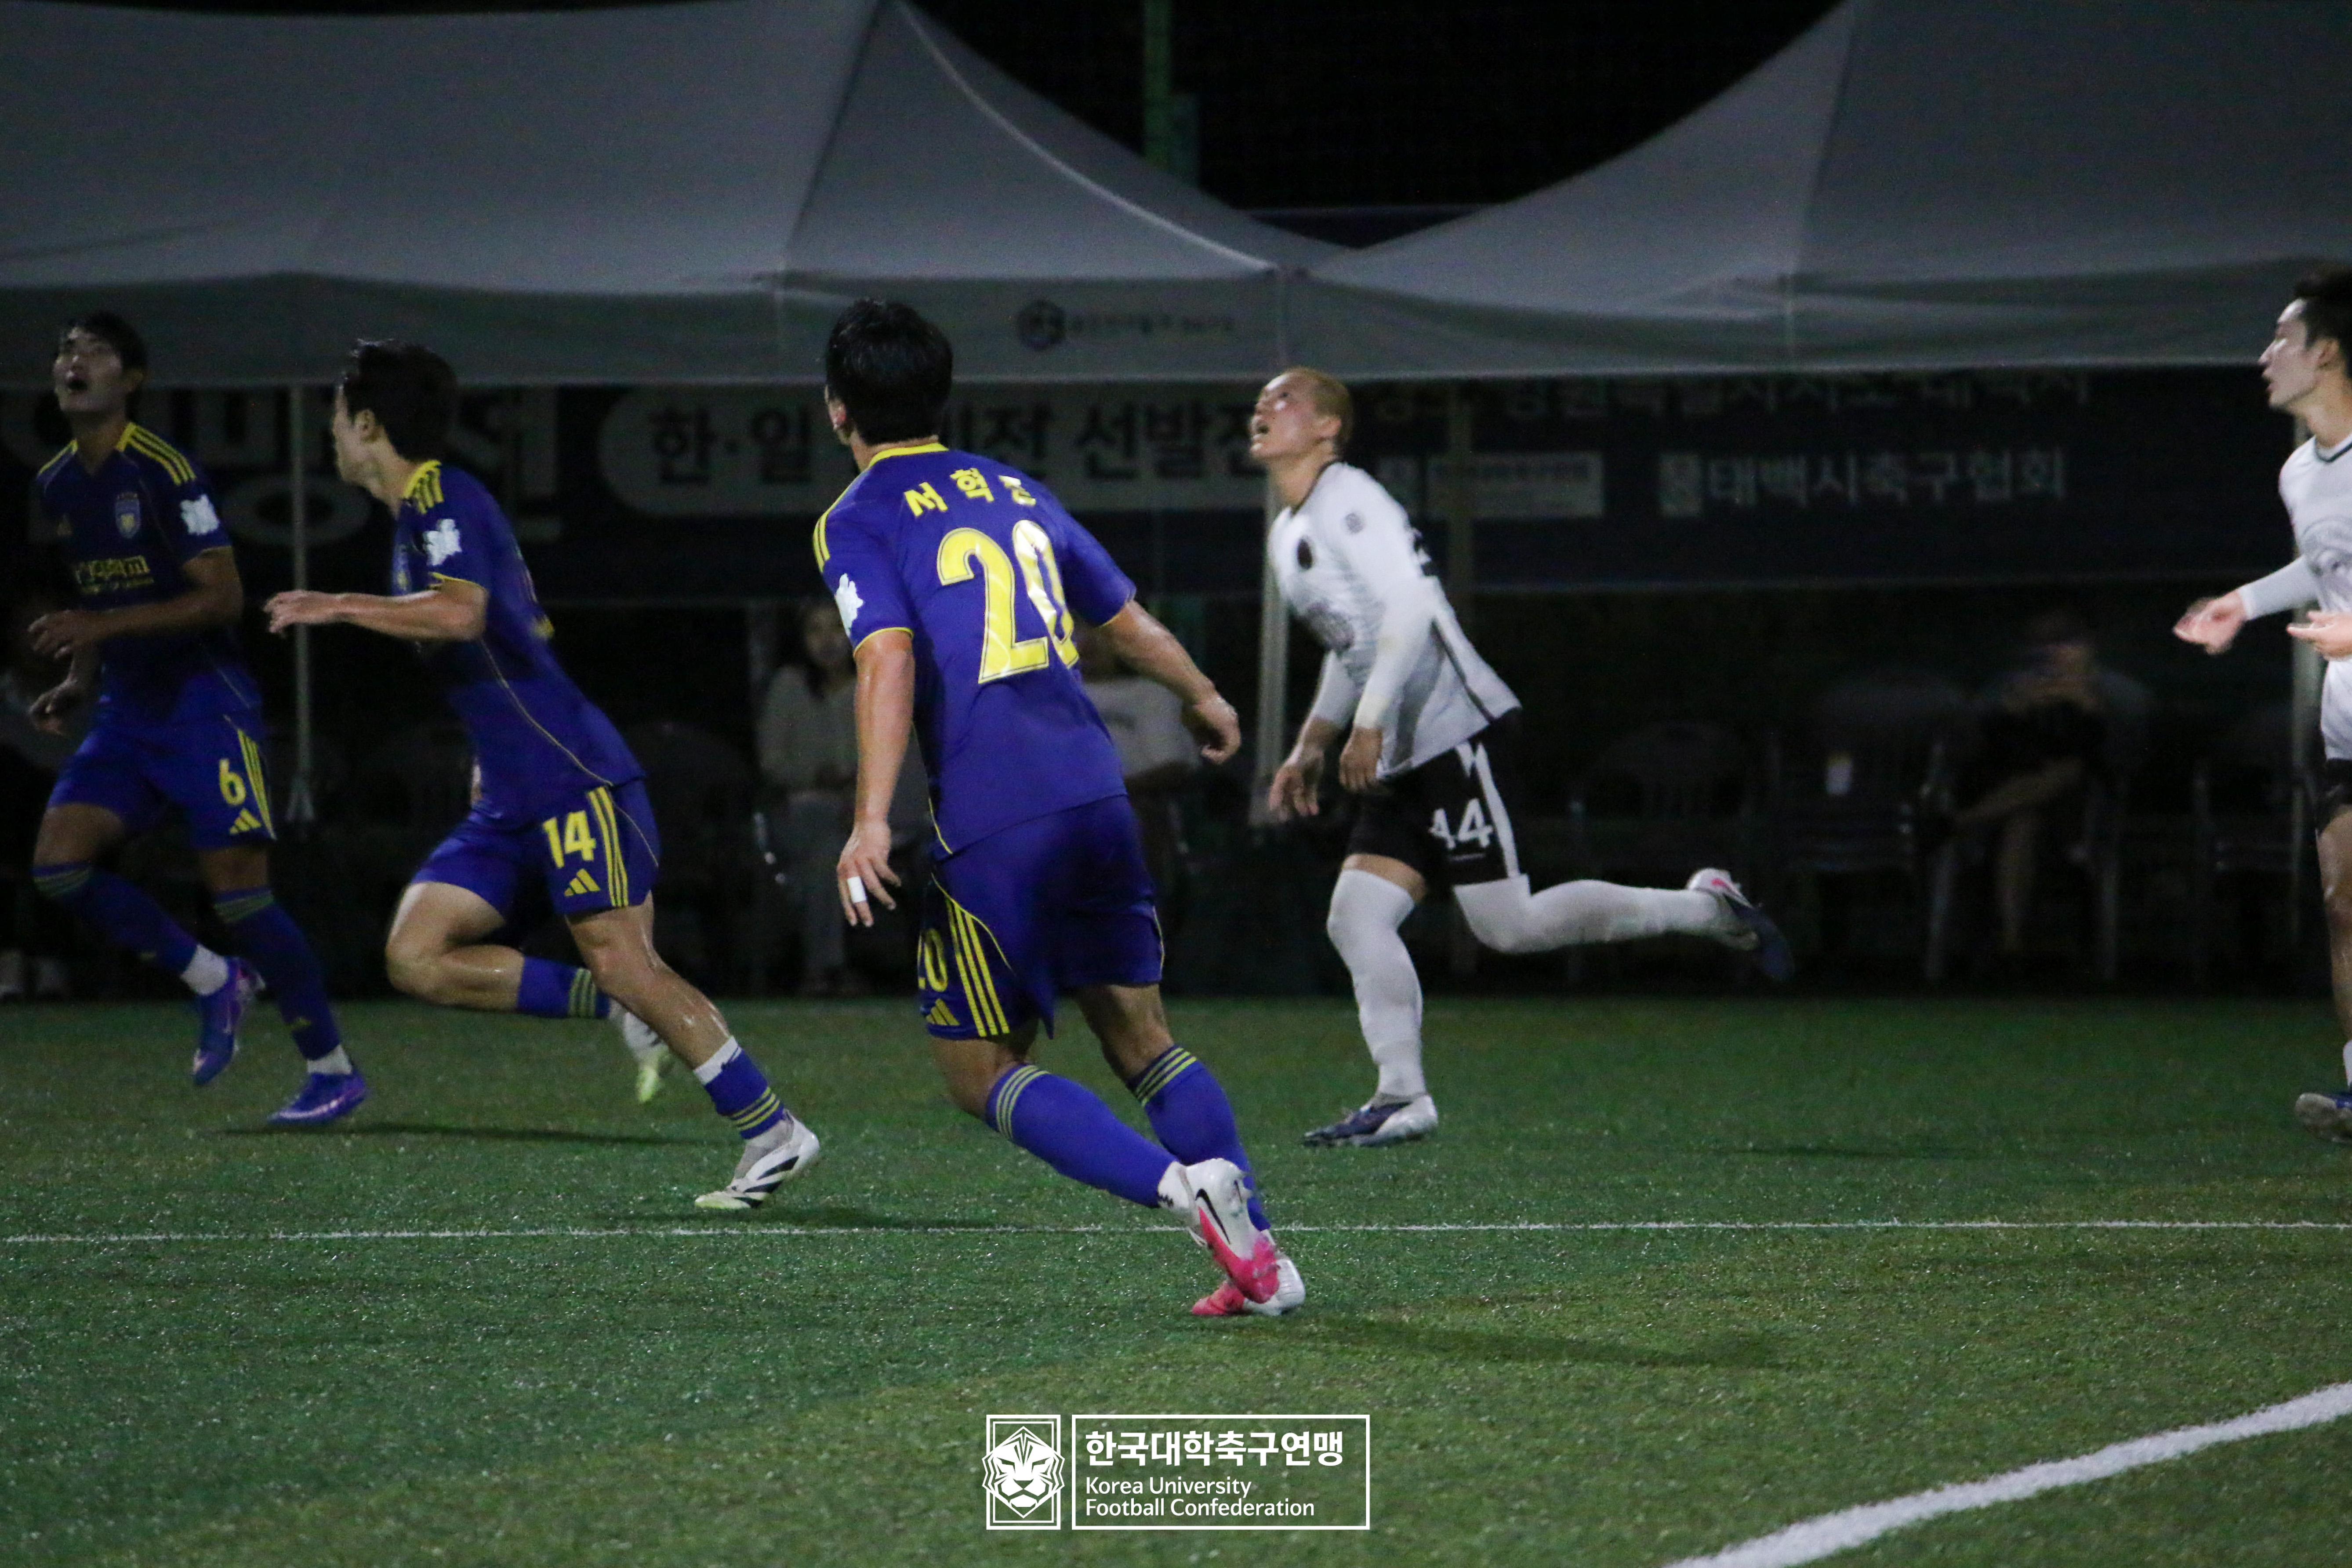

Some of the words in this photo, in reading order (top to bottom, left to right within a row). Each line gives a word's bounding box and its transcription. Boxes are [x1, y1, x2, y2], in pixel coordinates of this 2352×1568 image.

[650, 406, 813, 485] 한·일
[1707, 448, 2064, 508] 태백시축구협회
[936, 519, 1079, 684] 20
[219, 758, 247, 806] 6
[542, 810, 597, 870] 14
[1427, 797, 1494, 850] 44
